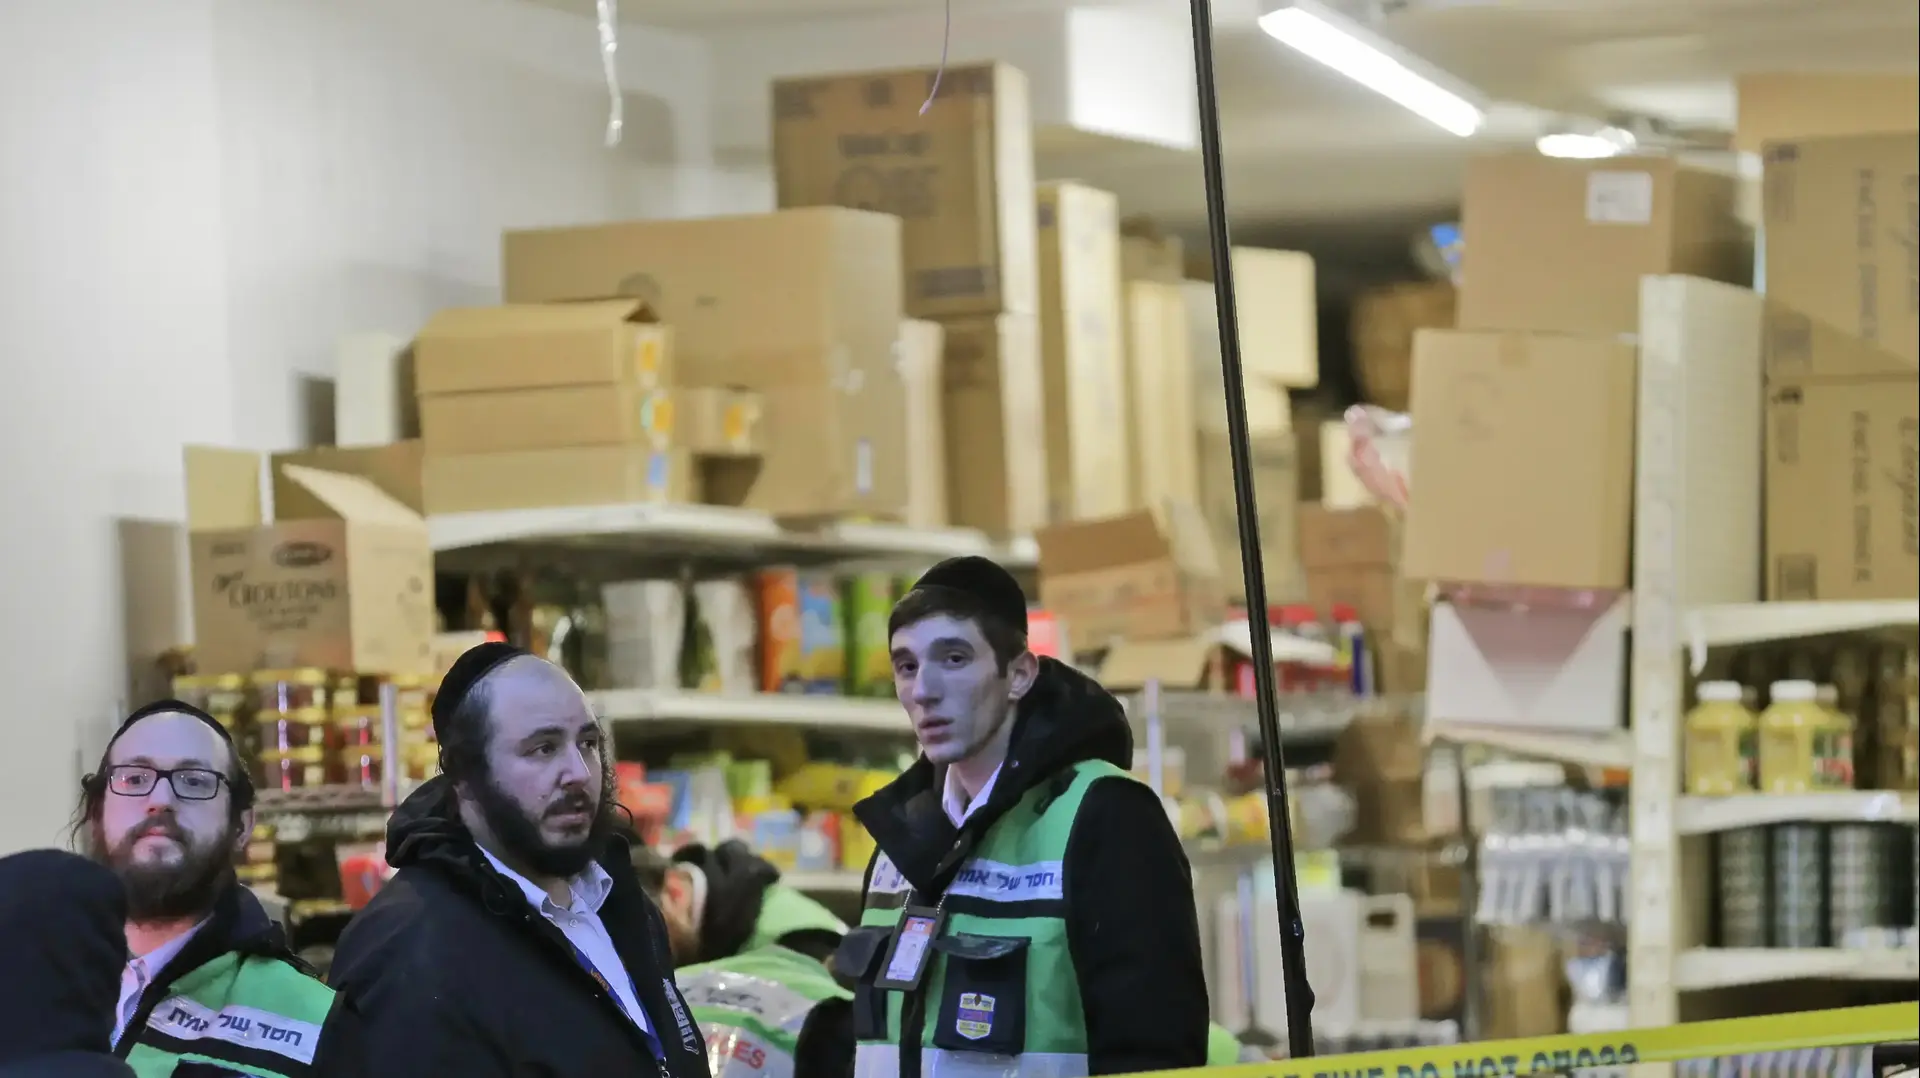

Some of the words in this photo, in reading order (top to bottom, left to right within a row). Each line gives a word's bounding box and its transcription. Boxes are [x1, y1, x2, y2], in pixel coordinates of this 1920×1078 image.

[996, 873, 1021, 890] של
[1025, 872, 1055, 888] חסד
[217, 1013, 251, 1032] של
[257, 1022, 302, 1046] חסד
